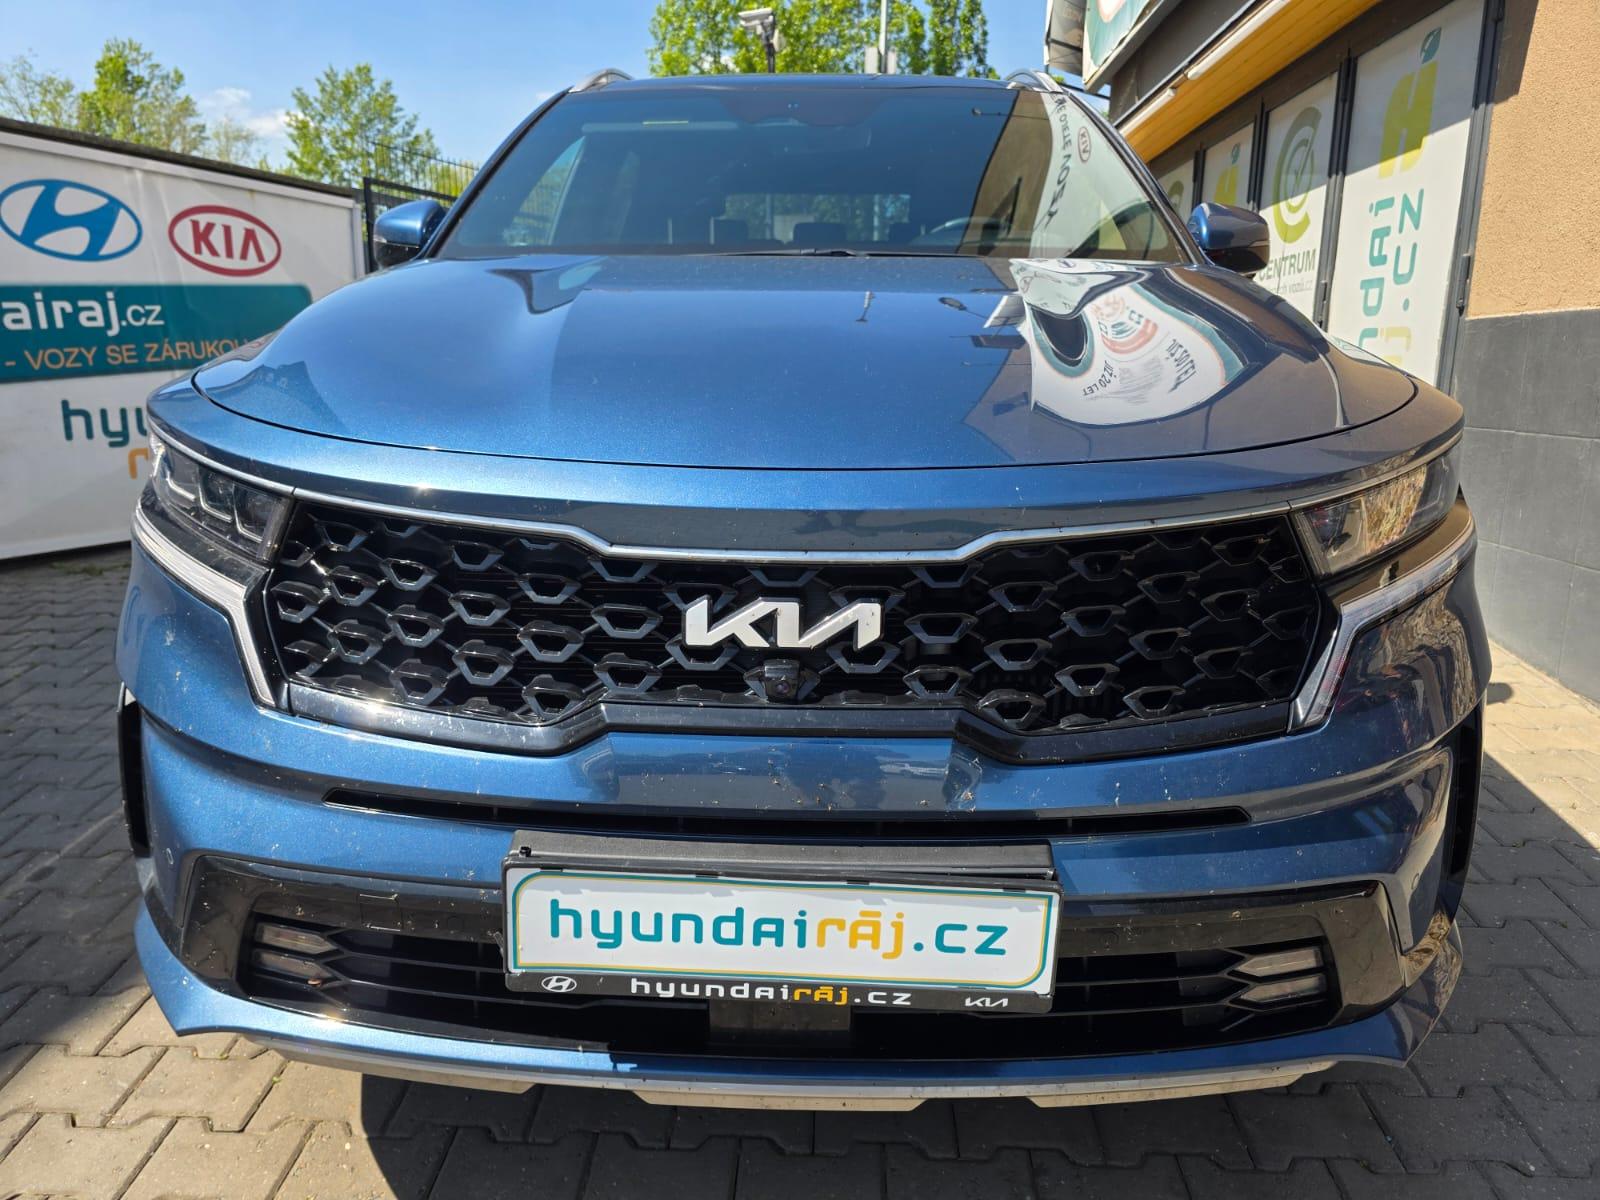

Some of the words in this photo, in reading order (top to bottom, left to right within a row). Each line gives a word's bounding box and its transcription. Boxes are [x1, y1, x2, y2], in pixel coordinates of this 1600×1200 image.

[190, 219, 266, 263] KIA
[24, 347, 97, 371] VOZY
[106, 344, 138, 365] SE
[144, 338, 242, 362] ZÁRUKO
[1083, 383, 1099, 395] LET
[685, 595, 882, 650] KIA
[964, 997, 1009, 1008] KIA
